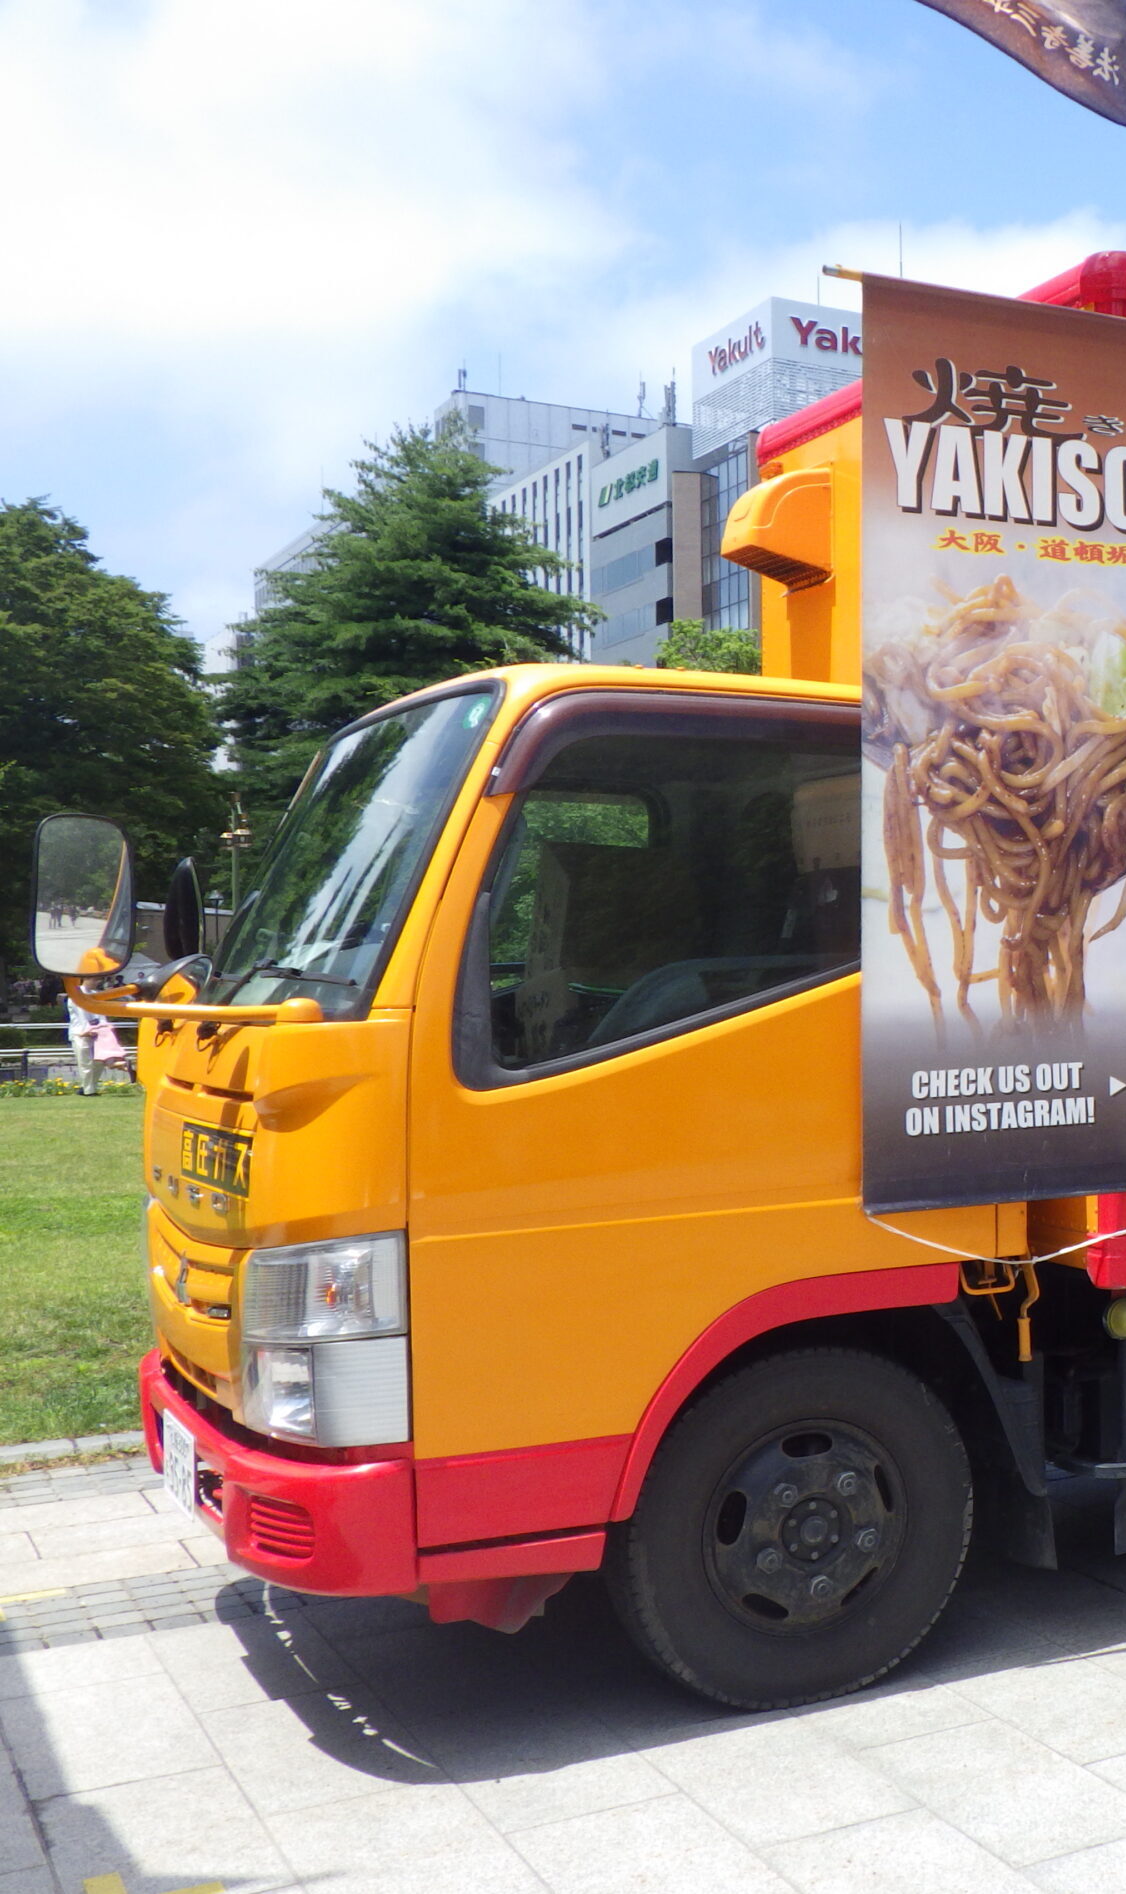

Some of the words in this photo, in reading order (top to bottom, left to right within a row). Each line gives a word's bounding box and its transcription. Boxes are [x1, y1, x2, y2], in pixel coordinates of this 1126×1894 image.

[708, 321, 766, 376] Yakult
[790, 316, 863, 356] Yak
[912, 1066, 993, 1100] CHECK
[999, 1064, 1032, 1094] US
[1036, 1062, 1084, 1092] OUT
[906, 1106, 940, 1136] ON
[945, 1097, 1096, 1134] INSTAGRAM!
